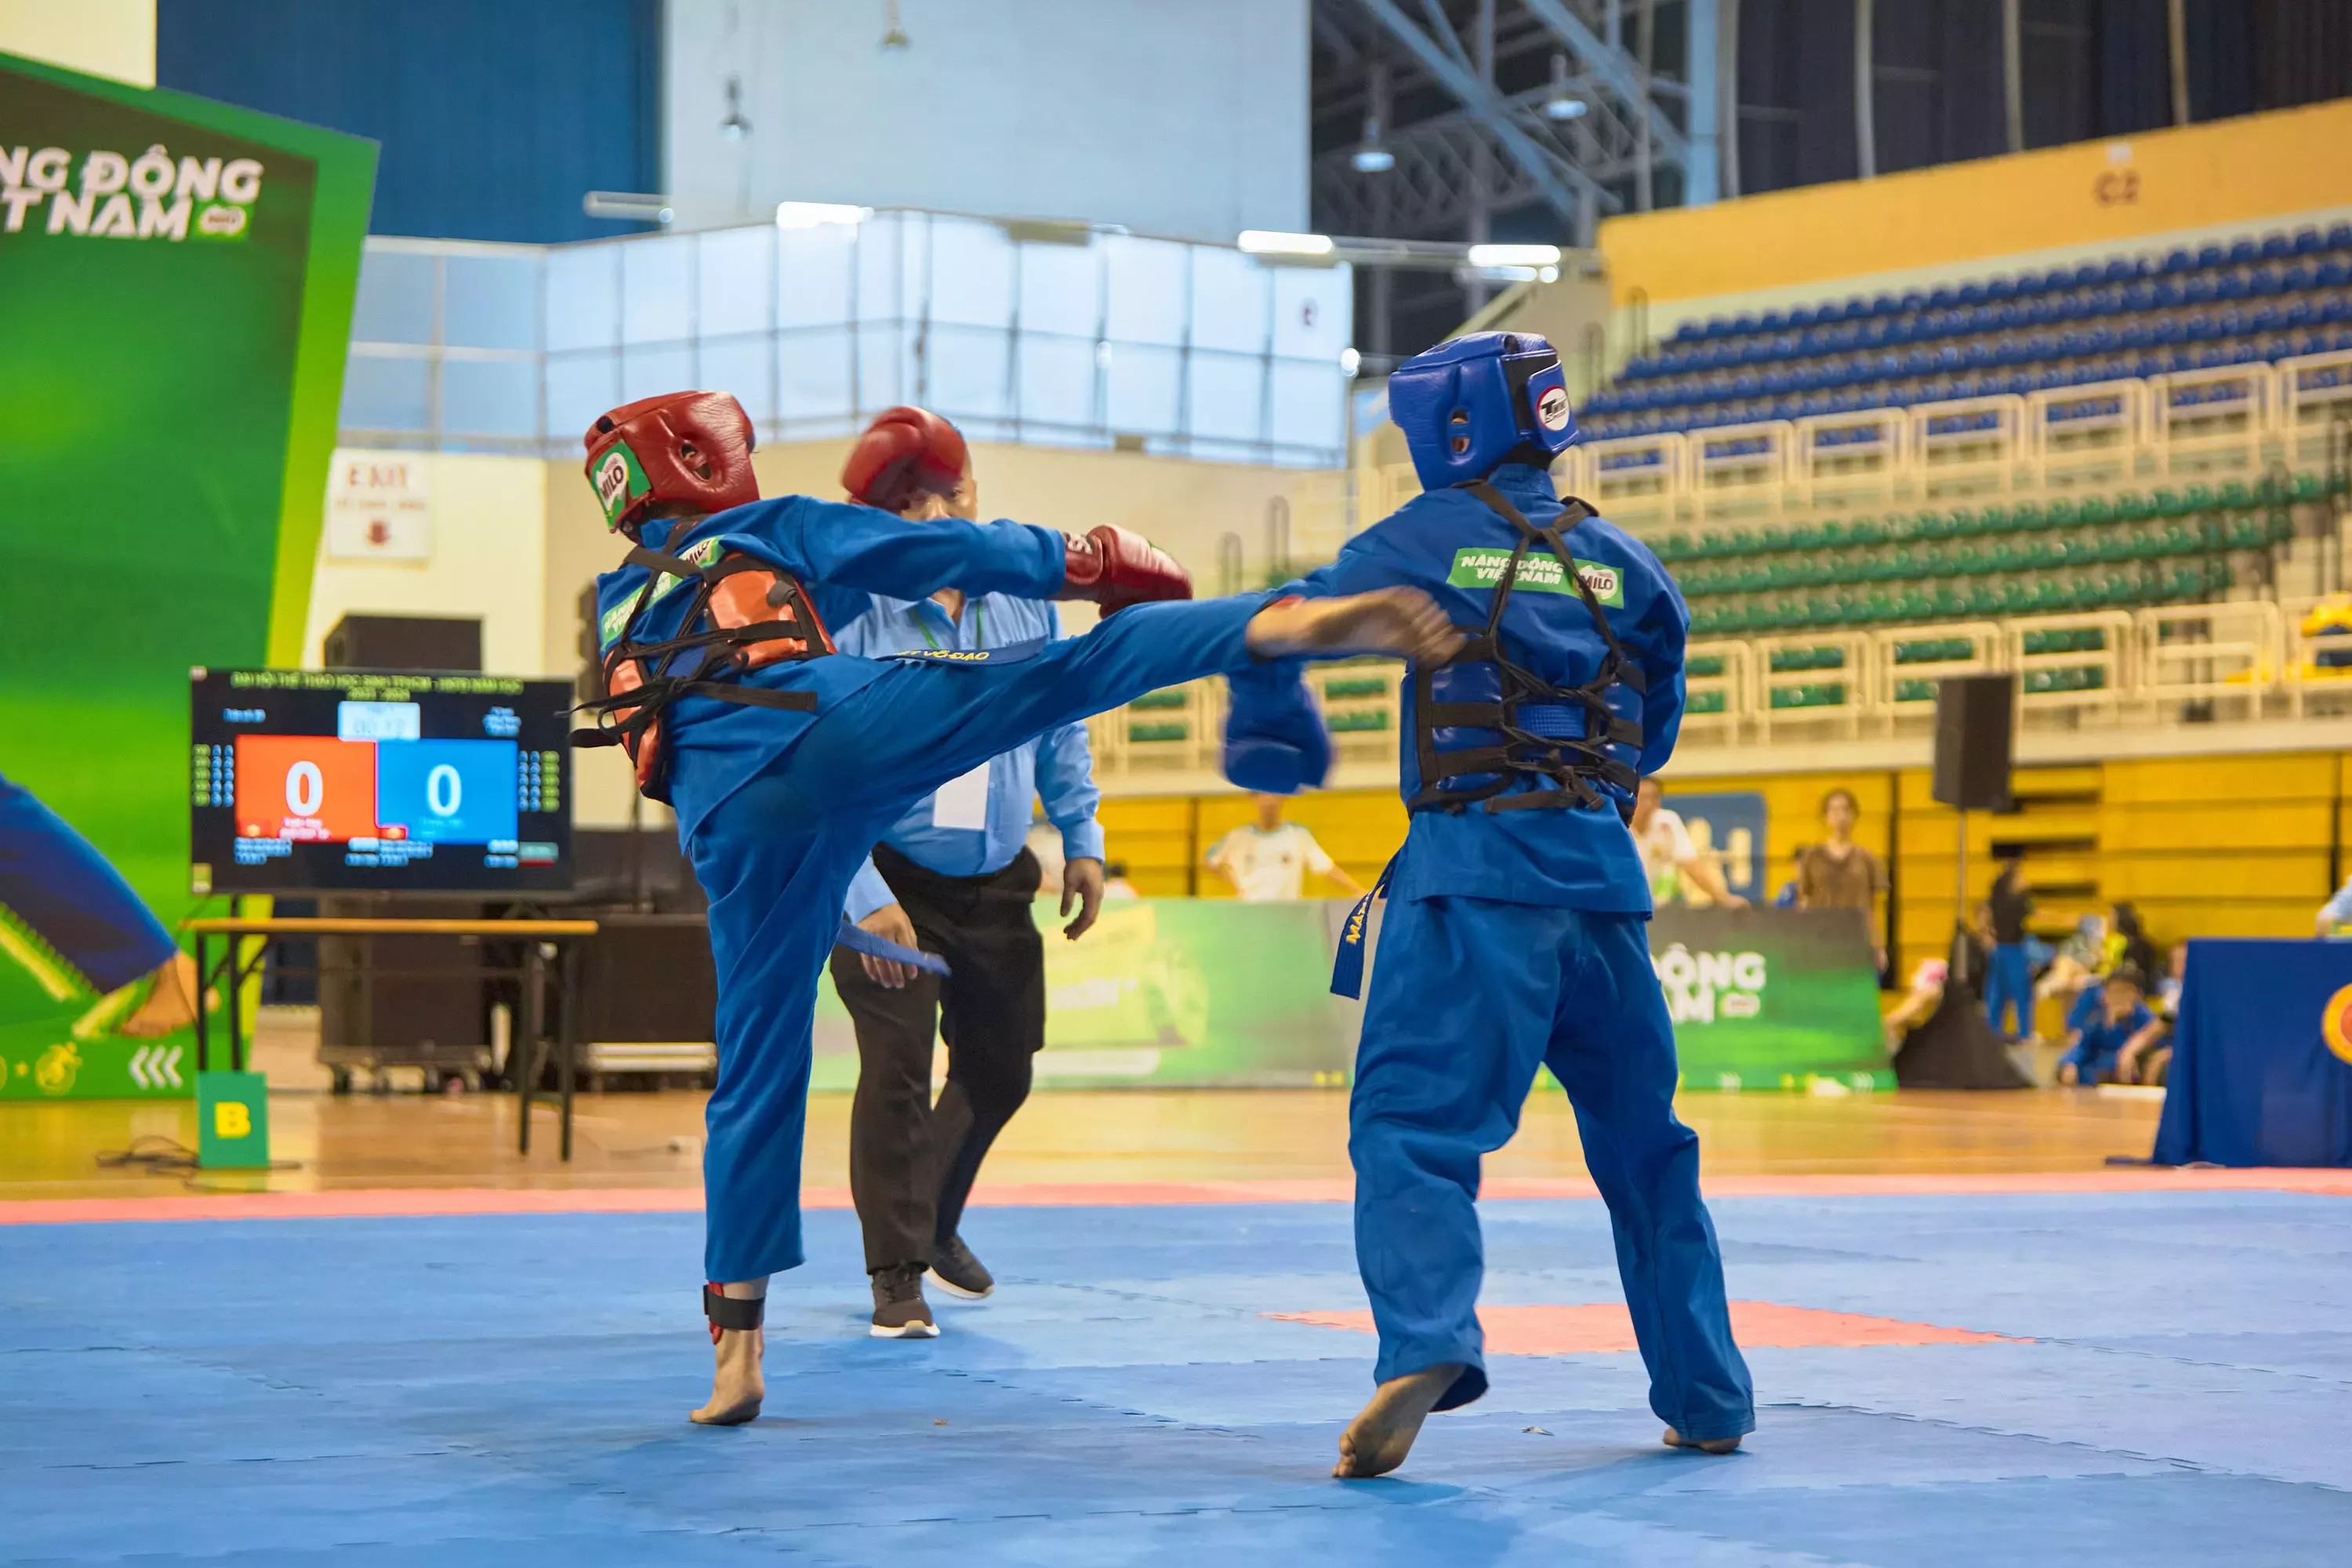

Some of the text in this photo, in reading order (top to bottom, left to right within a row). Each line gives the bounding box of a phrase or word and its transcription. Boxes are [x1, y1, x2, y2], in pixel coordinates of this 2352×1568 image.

[45, 190, 193, 242] NAM
[1579, 575, 1613, 590] MILO
[284, 760, 324, 816] 0
[426, 764, 463, 817] 0
[214, 1101, 252, 1139] B
